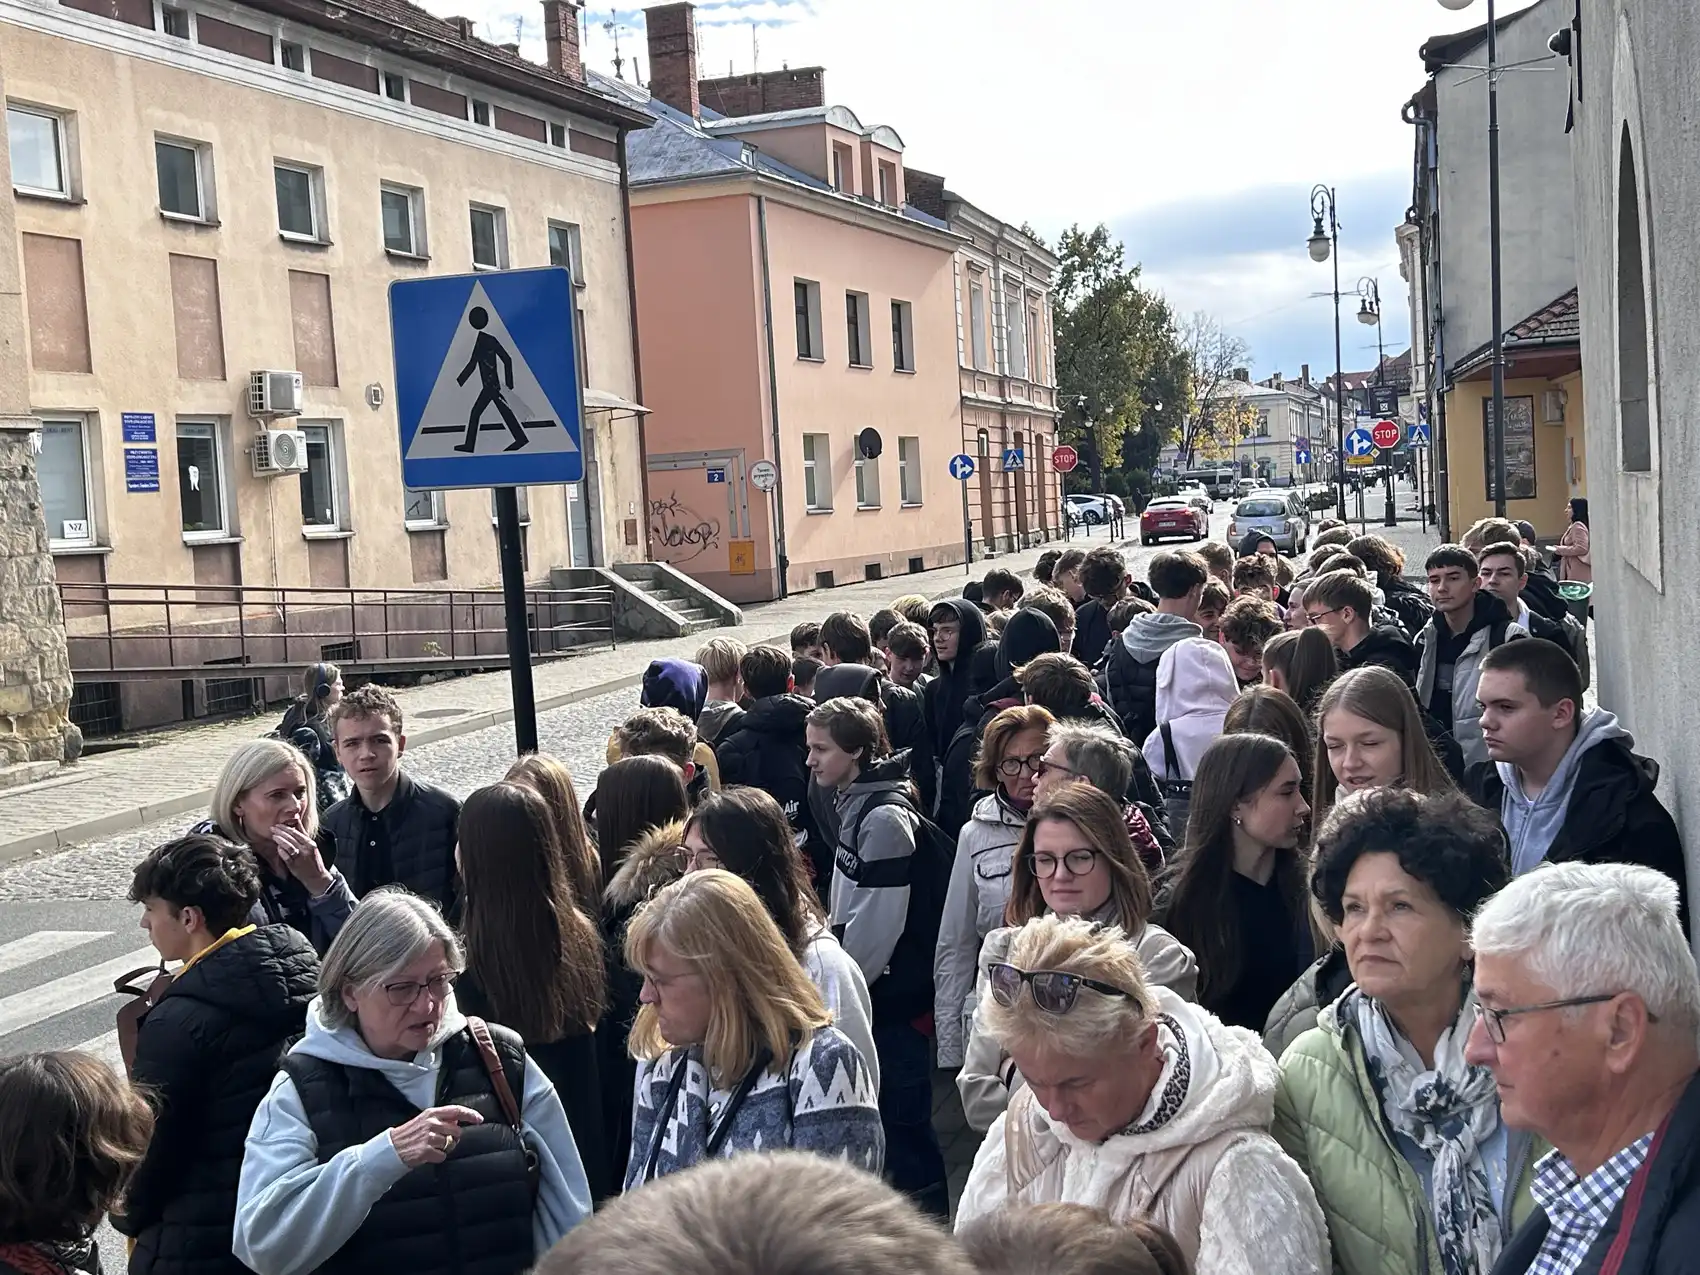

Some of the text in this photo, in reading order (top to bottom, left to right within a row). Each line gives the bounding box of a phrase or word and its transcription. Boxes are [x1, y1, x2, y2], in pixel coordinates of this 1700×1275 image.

[1374, 429, 1398, 440] STOP
[1054, 454, 1075, 464] STOP
[713, 473, 719, 482] 2
[784, 800, 800, 814] Air
